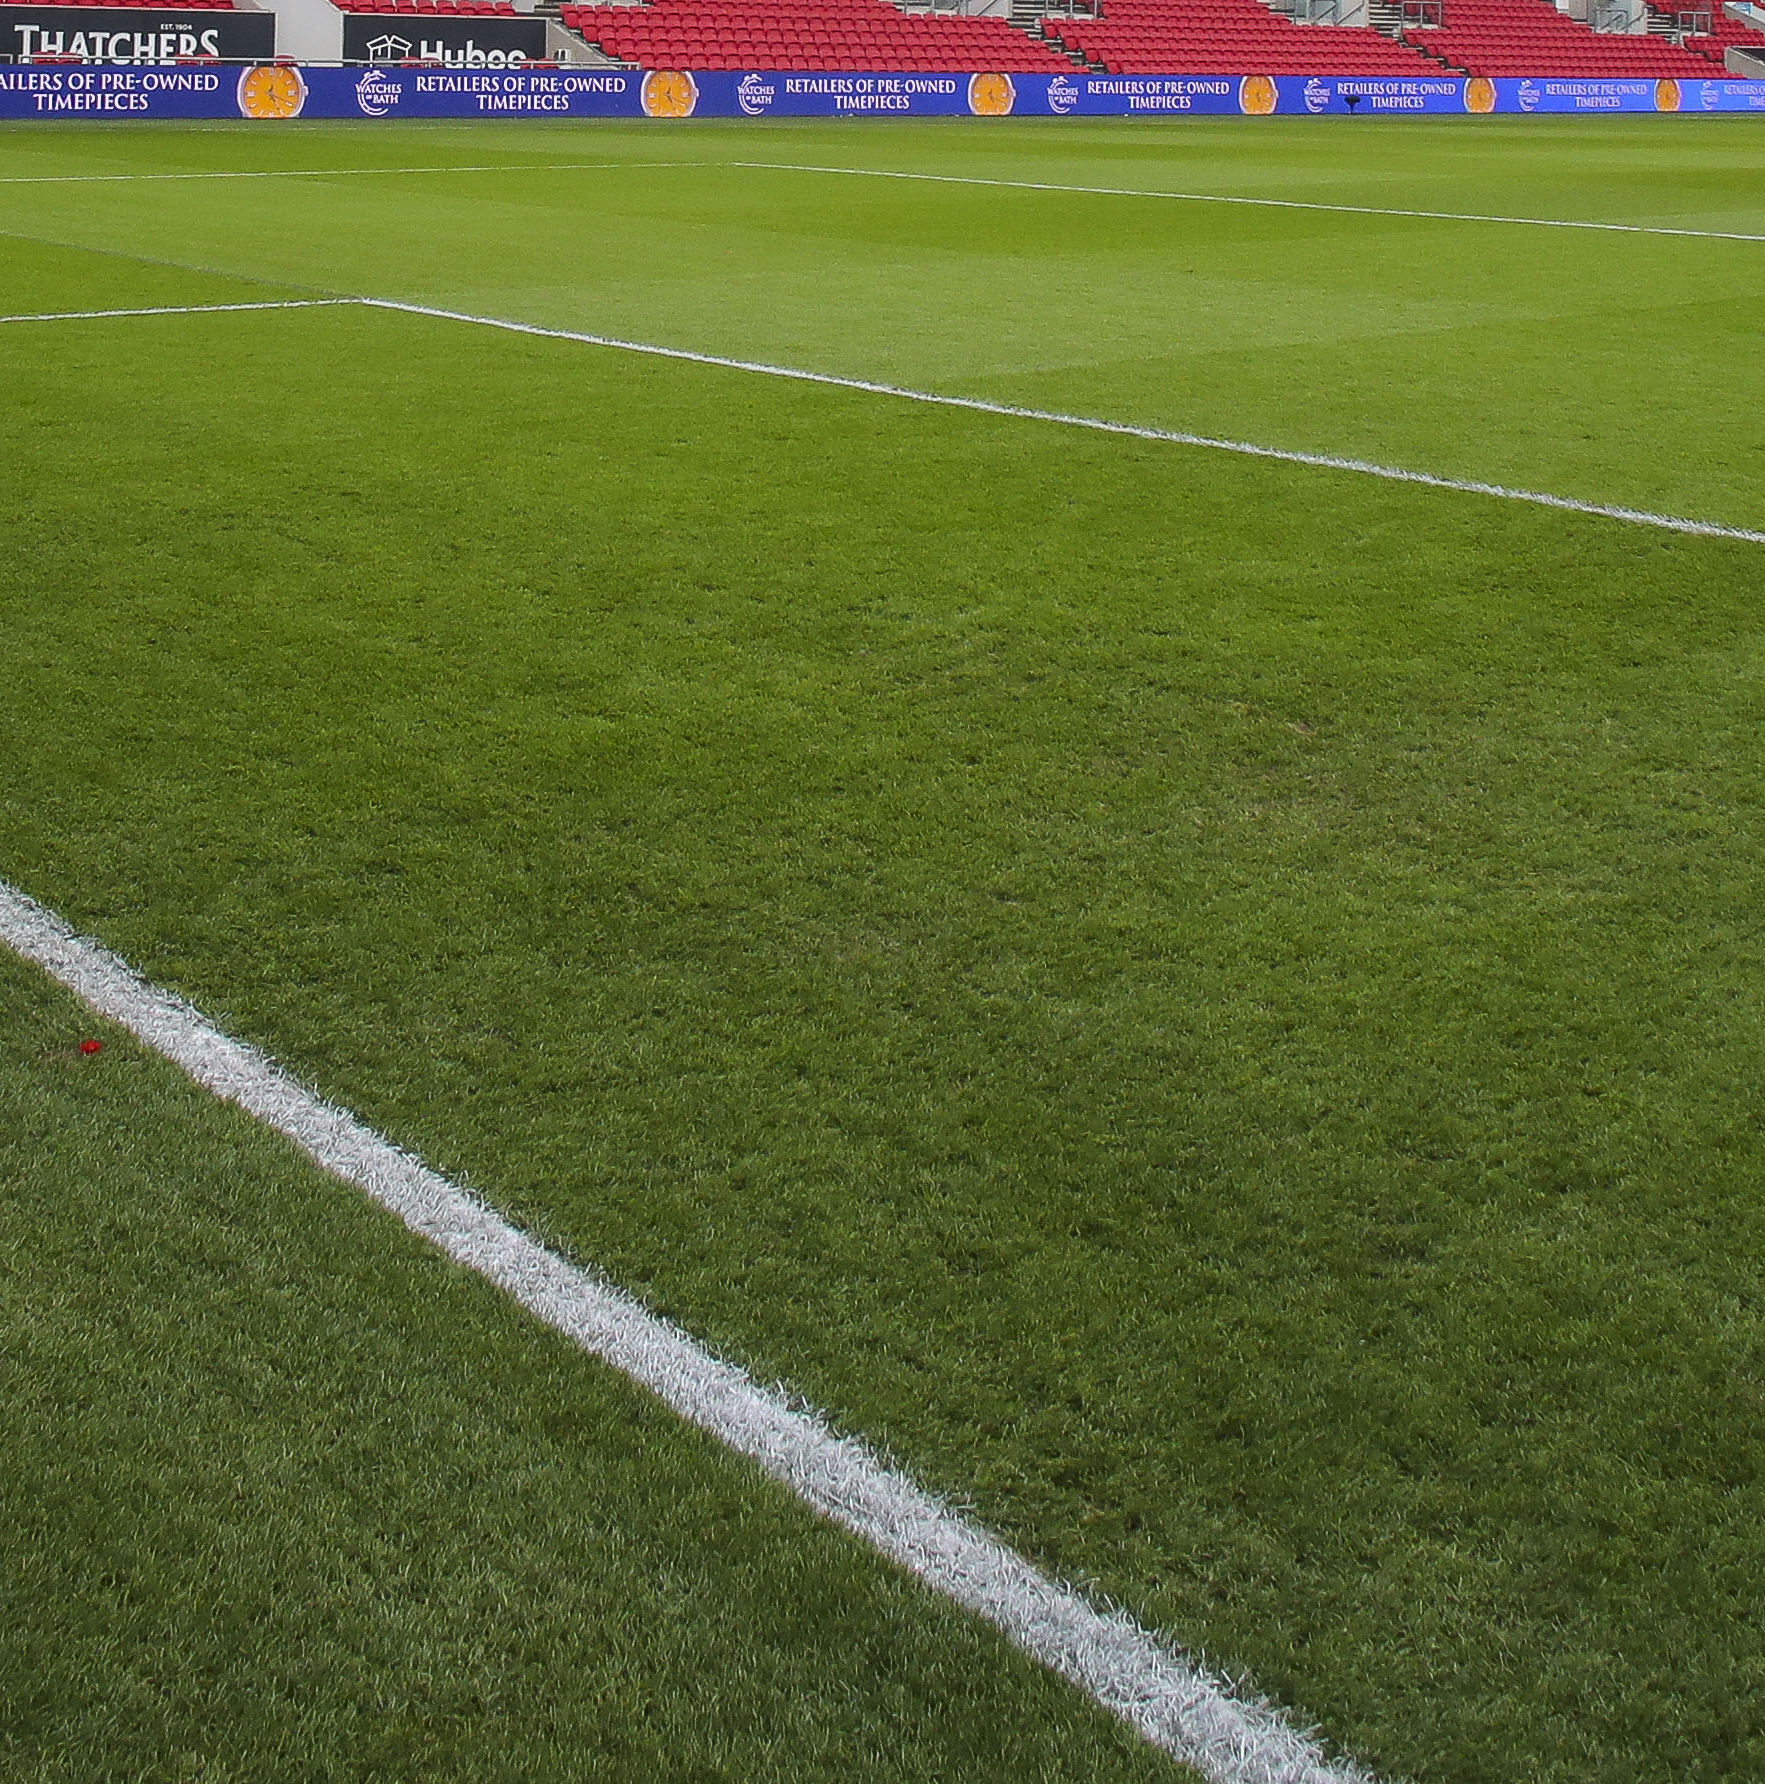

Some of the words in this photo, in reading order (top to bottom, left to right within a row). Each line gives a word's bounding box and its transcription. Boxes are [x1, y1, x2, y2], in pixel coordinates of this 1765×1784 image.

[14, 24, 219, 65] THATCHERS
[75, 73, 95, 90] OF
[102, 74, 218, 91] PRE-OWNED
[356, 83, 401, 94] WATCHES
[416, 76, 499, 92] RETAILERS
[504, 77, 525, 92] OF
[531, 77, 626, 93] PRE-OWNED
[786, 79, 853, 93] RETAILERS
[857, 80, 875, 93] OF
[878, 80, 956, 94] PRE-OWNED
[1088, 81, 1144, 94] RETAILERS
[1147, 82, 1163, 94] OF
[1165, 82, 1229, 94] PRE-OWNED
[1338, 82, 1384, 94] RETAILERS
[1386, 83, 1400, 94] OF
[1402, 83, 1456, 94] PRE-OWNED
[737, 85, 774, 95] WATCHES
[33, 94, 148, 110] TIMEPIECES
[373, 93, 399, 104] BATH
[476, 95, 569, 110] TIMEPIECES
[752, 94, 772, 104] BATH
[835, 95, 909, 109] TIMEPIECES
[1129, 96, 1191, 109] TIMEPIECES
[1372, 96, 1424, 108] TIMEPIECES
